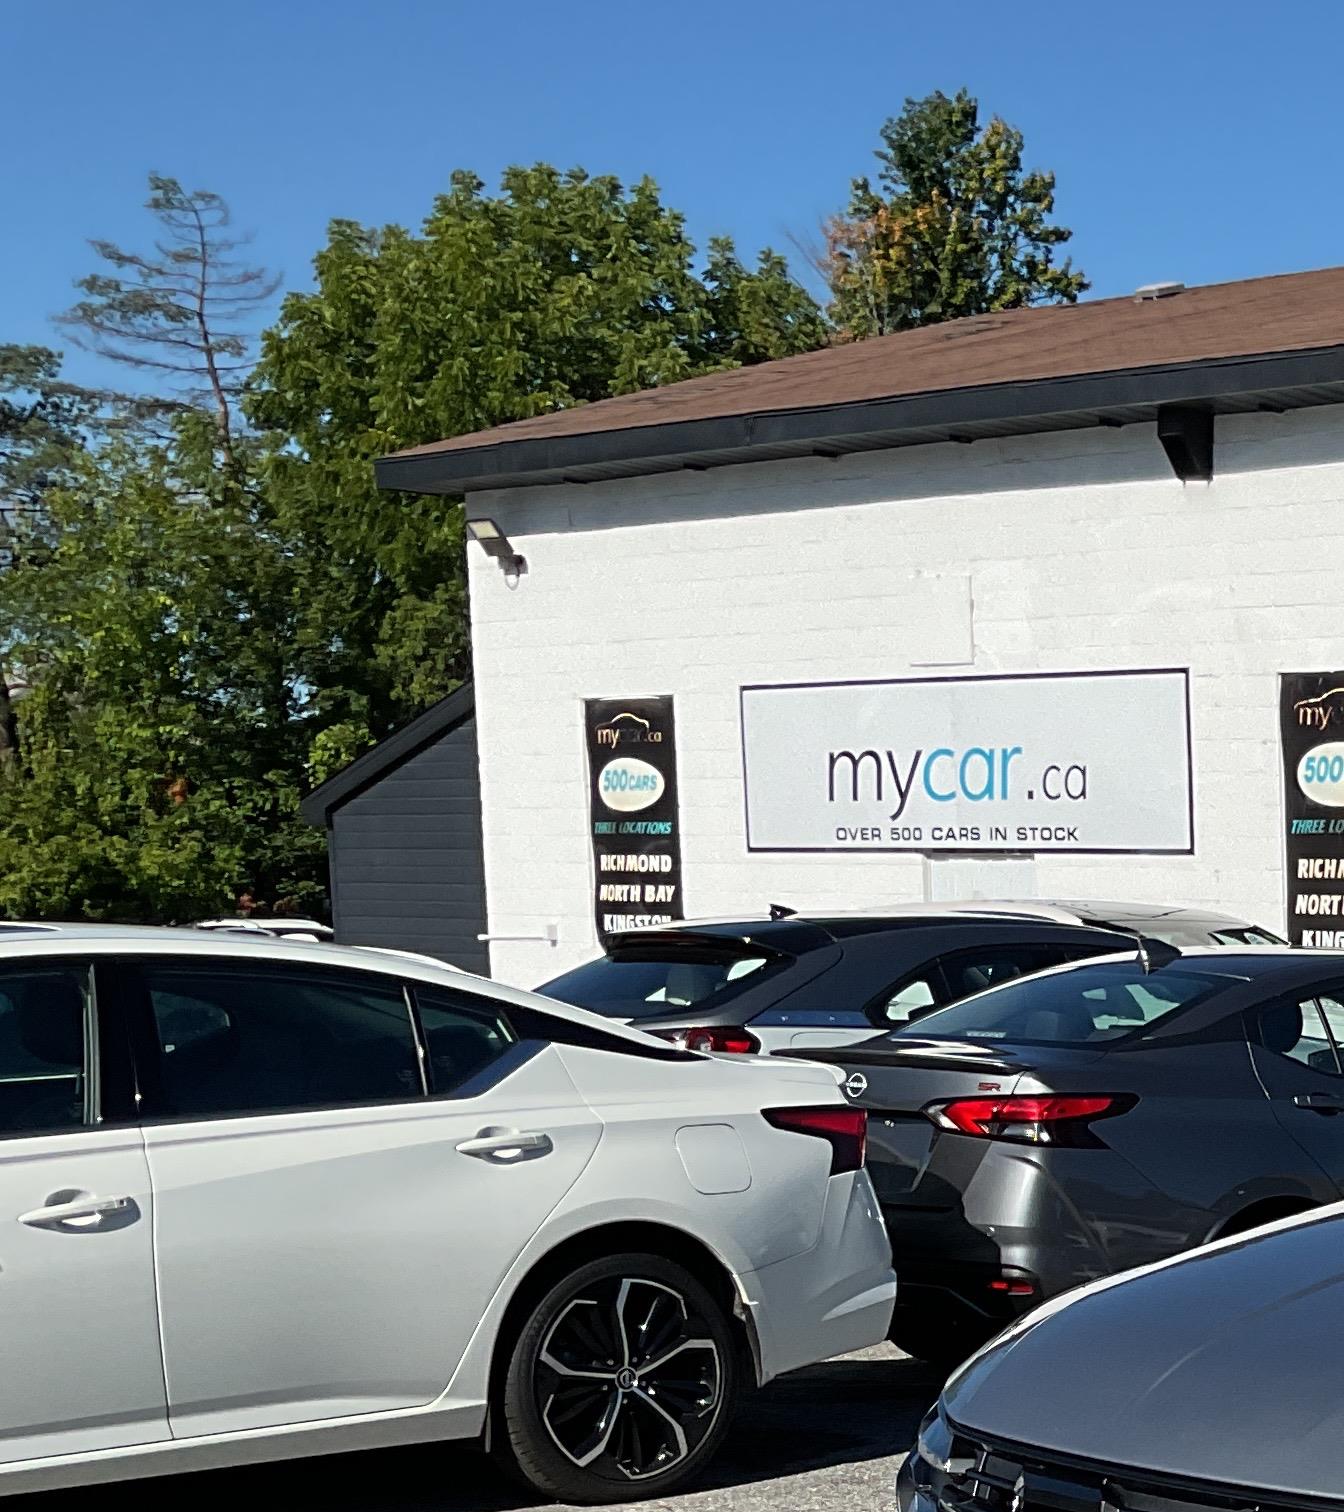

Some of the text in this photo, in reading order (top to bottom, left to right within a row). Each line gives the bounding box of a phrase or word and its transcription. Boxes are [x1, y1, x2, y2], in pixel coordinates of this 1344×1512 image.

[828, 746, 1087, 821] mycar.ca
[618, 822, 672, 835] LOCATIONS
[836, 827, 1079, 841] OVER 500 CARS IN STOCK
[1291, 819, 1325, 835] THREE
[600, 854, 672, 872] RICHMOND
[600, 885, 675, 902] NORTH BAY
